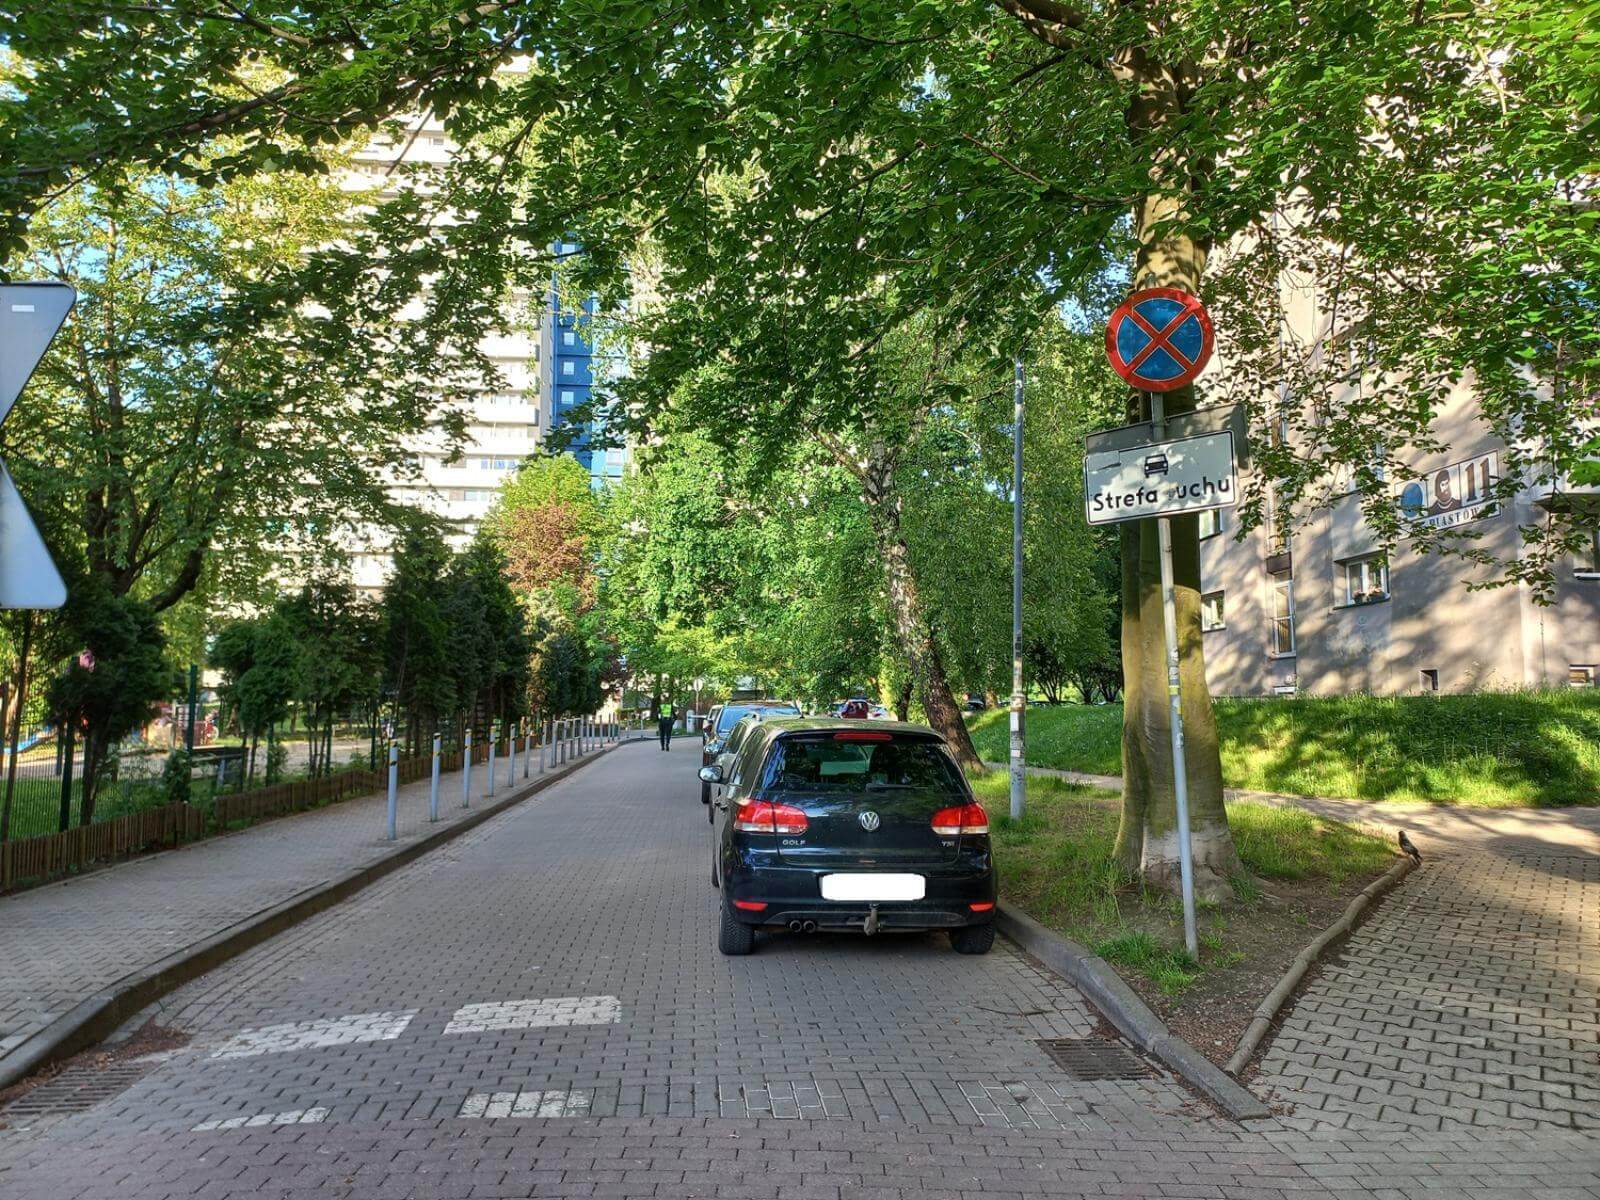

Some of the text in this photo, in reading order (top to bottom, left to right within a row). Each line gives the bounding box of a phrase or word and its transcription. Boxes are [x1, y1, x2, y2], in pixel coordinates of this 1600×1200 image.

[1093, 476, 1230, 511] Strefa uchu
[1465, 457, 1492, 502] 11
